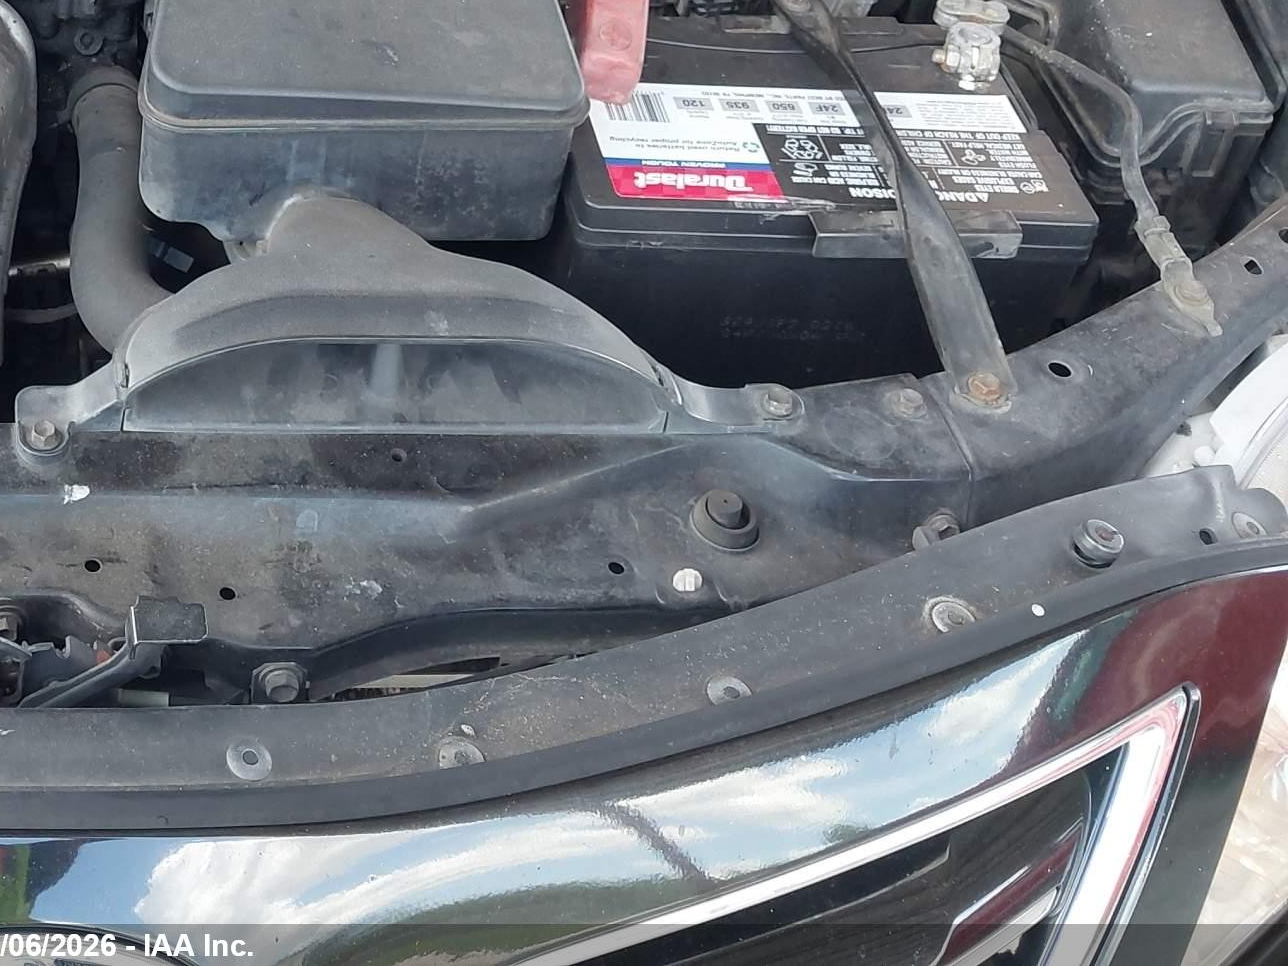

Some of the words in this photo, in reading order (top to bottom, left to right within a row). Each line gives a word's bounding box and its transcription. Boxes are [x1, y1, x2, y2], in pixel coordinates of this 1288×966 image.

[682, 99, 706, 107] 120
[726, 101, 750, 110] 935
[772, 103, 796, 111] 650
[815, 104, 838, 113] 24F
[634, 171, 754, 192] Duralast
